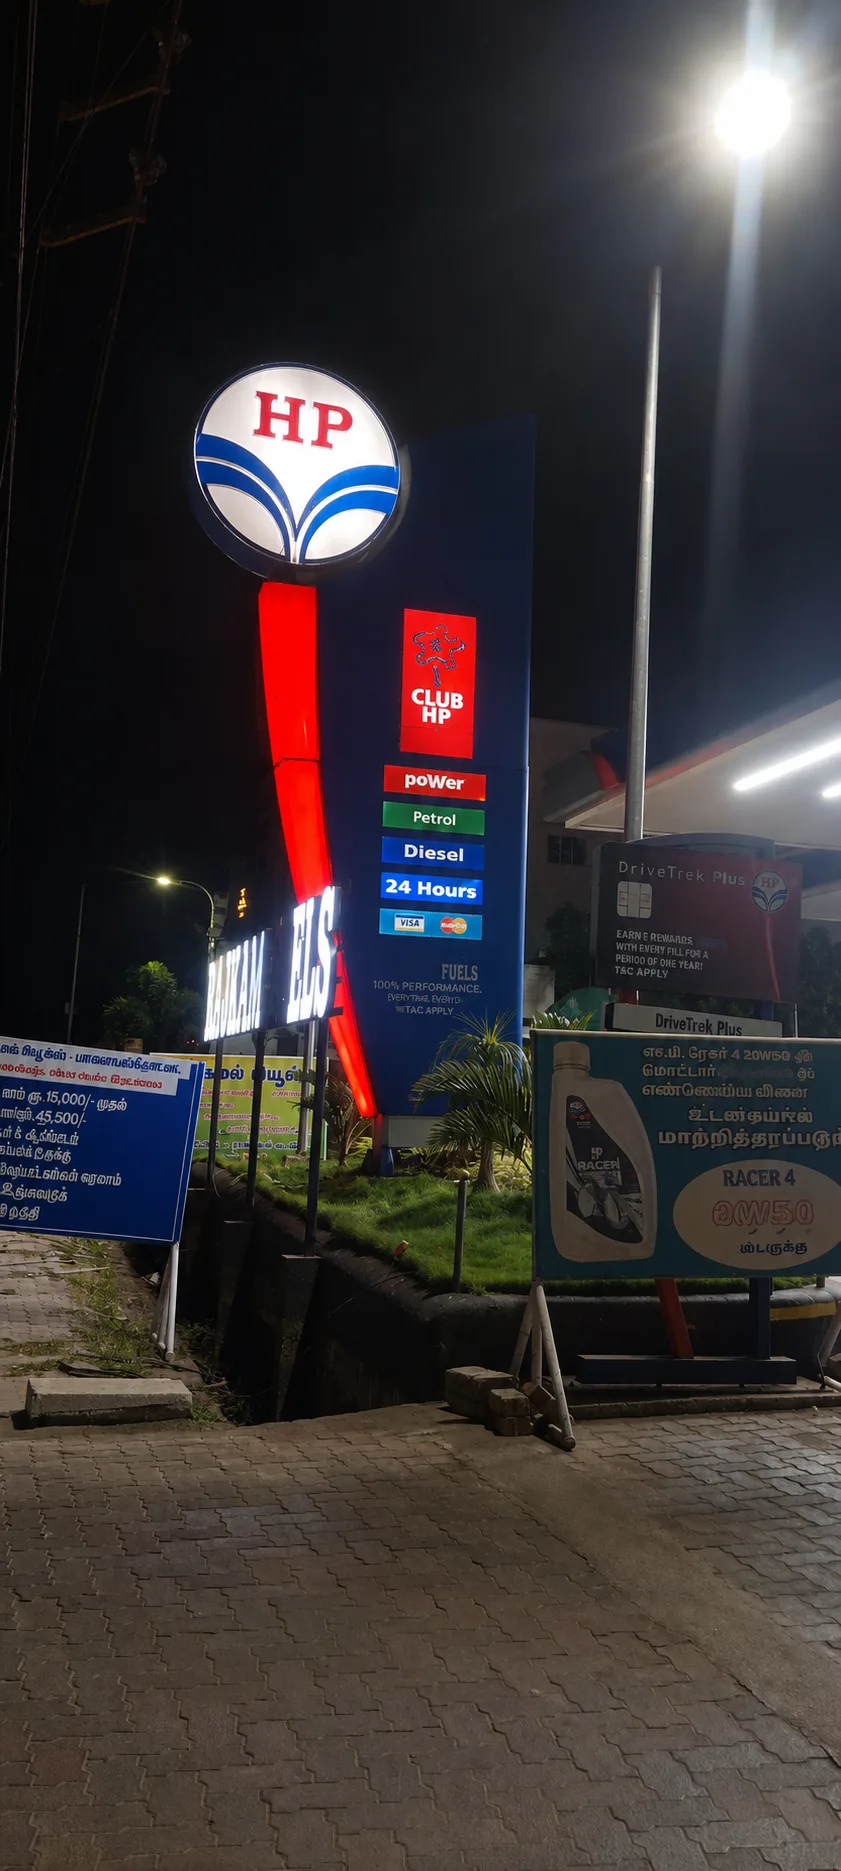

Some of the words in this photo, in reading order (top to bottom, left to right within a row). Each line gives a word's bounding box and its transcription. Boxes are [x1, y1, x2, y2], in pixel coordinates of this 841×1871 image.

[253, 390, 354, 449] HP
[411, 688, 464, 709] CLUB
[422, 706, 452, 725] HP
[413, 811, 456, 826] Petrol
[404, 843, 464, 862] Diesel
[619, 861, 704, 882] DriveTrek
[713, 871, 746, 886] Plus
[761, 877, 780, 888] HP
[385, 879, 411, 894] 24
[417, 881, 477, 899] Hours
[400, 918, 420, 927] VISA
[616, 930, 641, 941] EARN
[616, 942, 637, 952] WITH
[639, 944, 665, 955] EVERY
[667, 947, 684, 957] FILL
[703, 951, 709, 960] A
[441, 963, 479, 981] FUELS
[636, 967, 669, 979] APPLY
[647, 957, 658, 966] OF
[660, 958, 677, 969] ONE
[678, 960, 703, 971] YEAR!
[373, 980, 400, 990] 100%
[425, 1007, 454, 1016] APPLY
[655, 1013, 713, 1033] DriveTrek
[716, 1021, 743, 1037] Plus
[731, 1049, 740, 1060] 4
[722, 1169, 781, 1187] RACER
[784, 1168, 796, 1186] 4
